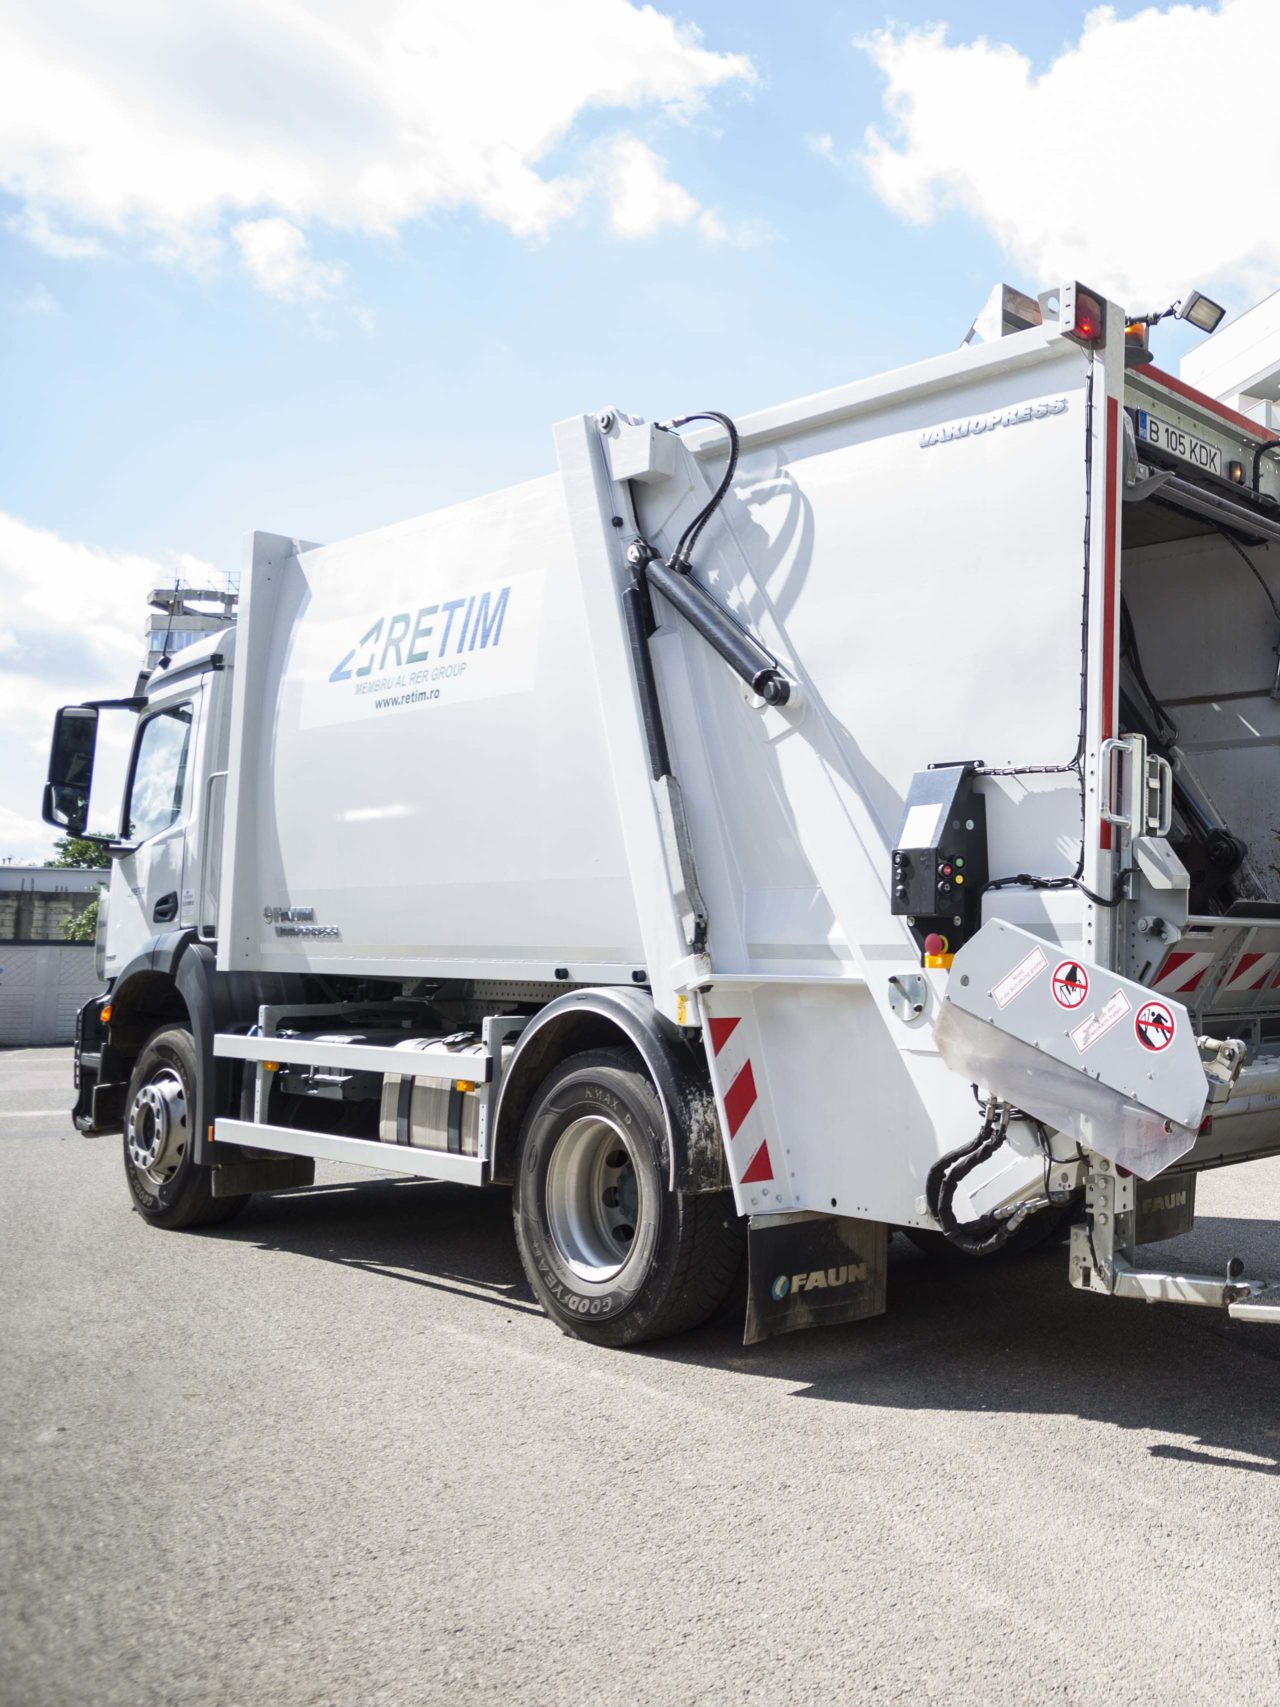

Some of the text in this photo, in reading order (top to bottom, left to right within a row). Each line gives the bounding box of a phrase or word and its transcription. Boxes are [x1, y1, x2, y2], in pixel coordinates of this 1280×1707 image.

[920, 398, 1069, 448] VARIOPRESS
[1149, 420, 1218, 473] B 105 KDK
[379, 586, 511, 670] RETIM
[355, 662, 468, 695] MEMBRU AL RER GROUP
[374, 688, 440, 709] www.retim.ro
[1142, 1191, 1187, 1214] FAUN
[790, 1262, 868, 1294] FAUN
